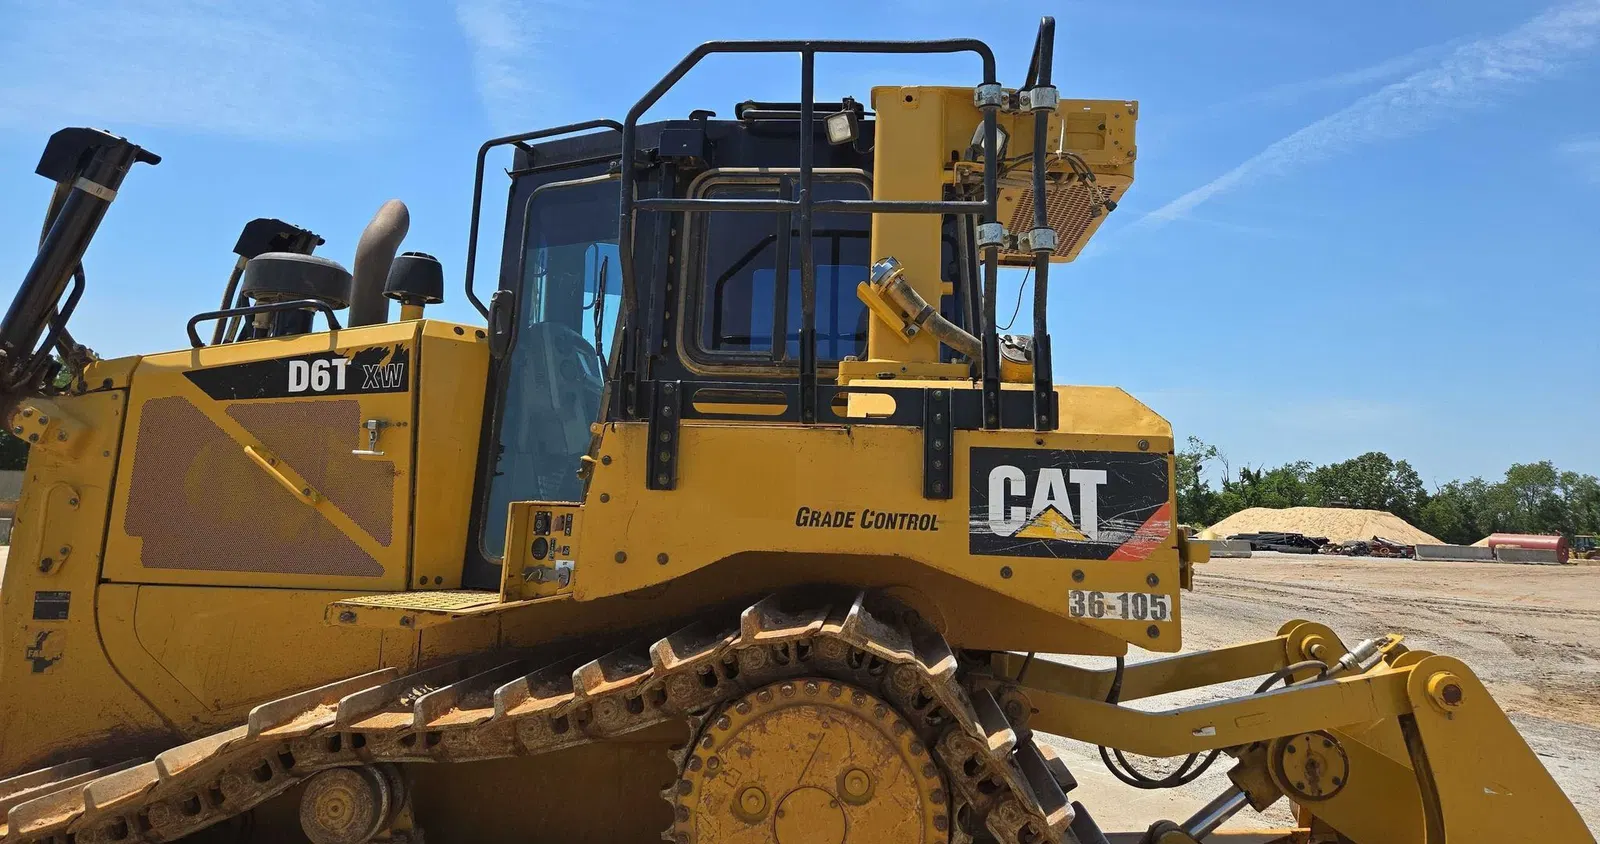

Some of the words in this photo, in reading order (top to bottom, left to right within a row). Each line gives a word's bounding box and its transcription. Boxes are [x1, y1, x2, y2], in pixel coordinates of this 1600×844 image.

[288, 357, 352, 393] D6T
[361, 362, 404, 389] XW
[795, 506, 856, 529] GRADE
[860, 508, 939, 532] CONTROL
[988, 464, 1107, 541] CAT
[1069, 589, 1168, 621] 36-105
